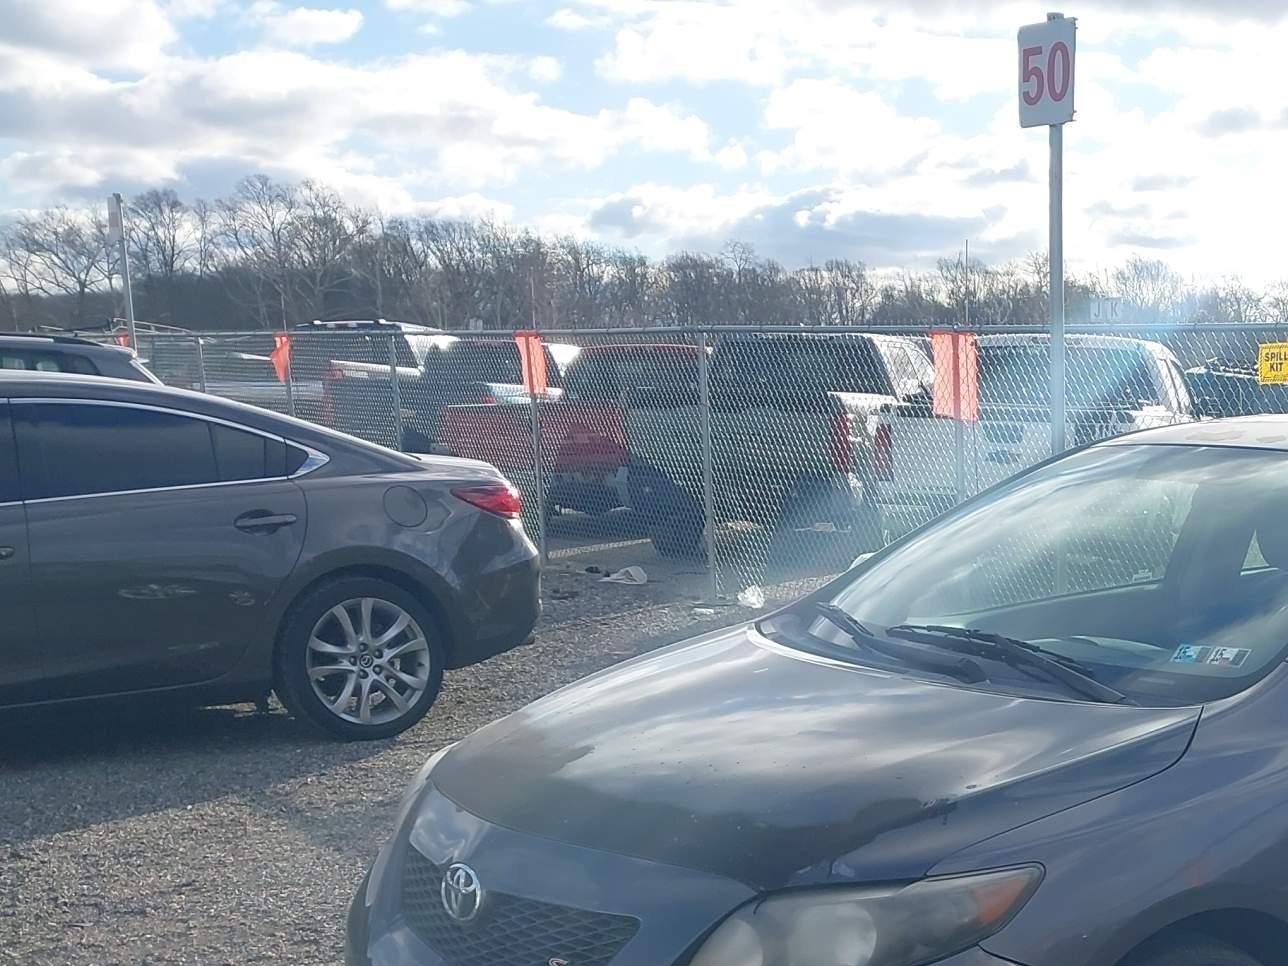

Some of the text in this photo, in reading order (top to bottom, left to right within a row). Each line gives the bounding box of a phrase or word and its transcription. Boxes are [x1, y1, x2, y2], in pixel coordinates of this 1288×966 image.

[1022, 41, 1071, 106] 50
[1264, 351, 1288, 361] SPILL
[1269, 362, 1284, 371] KIT
